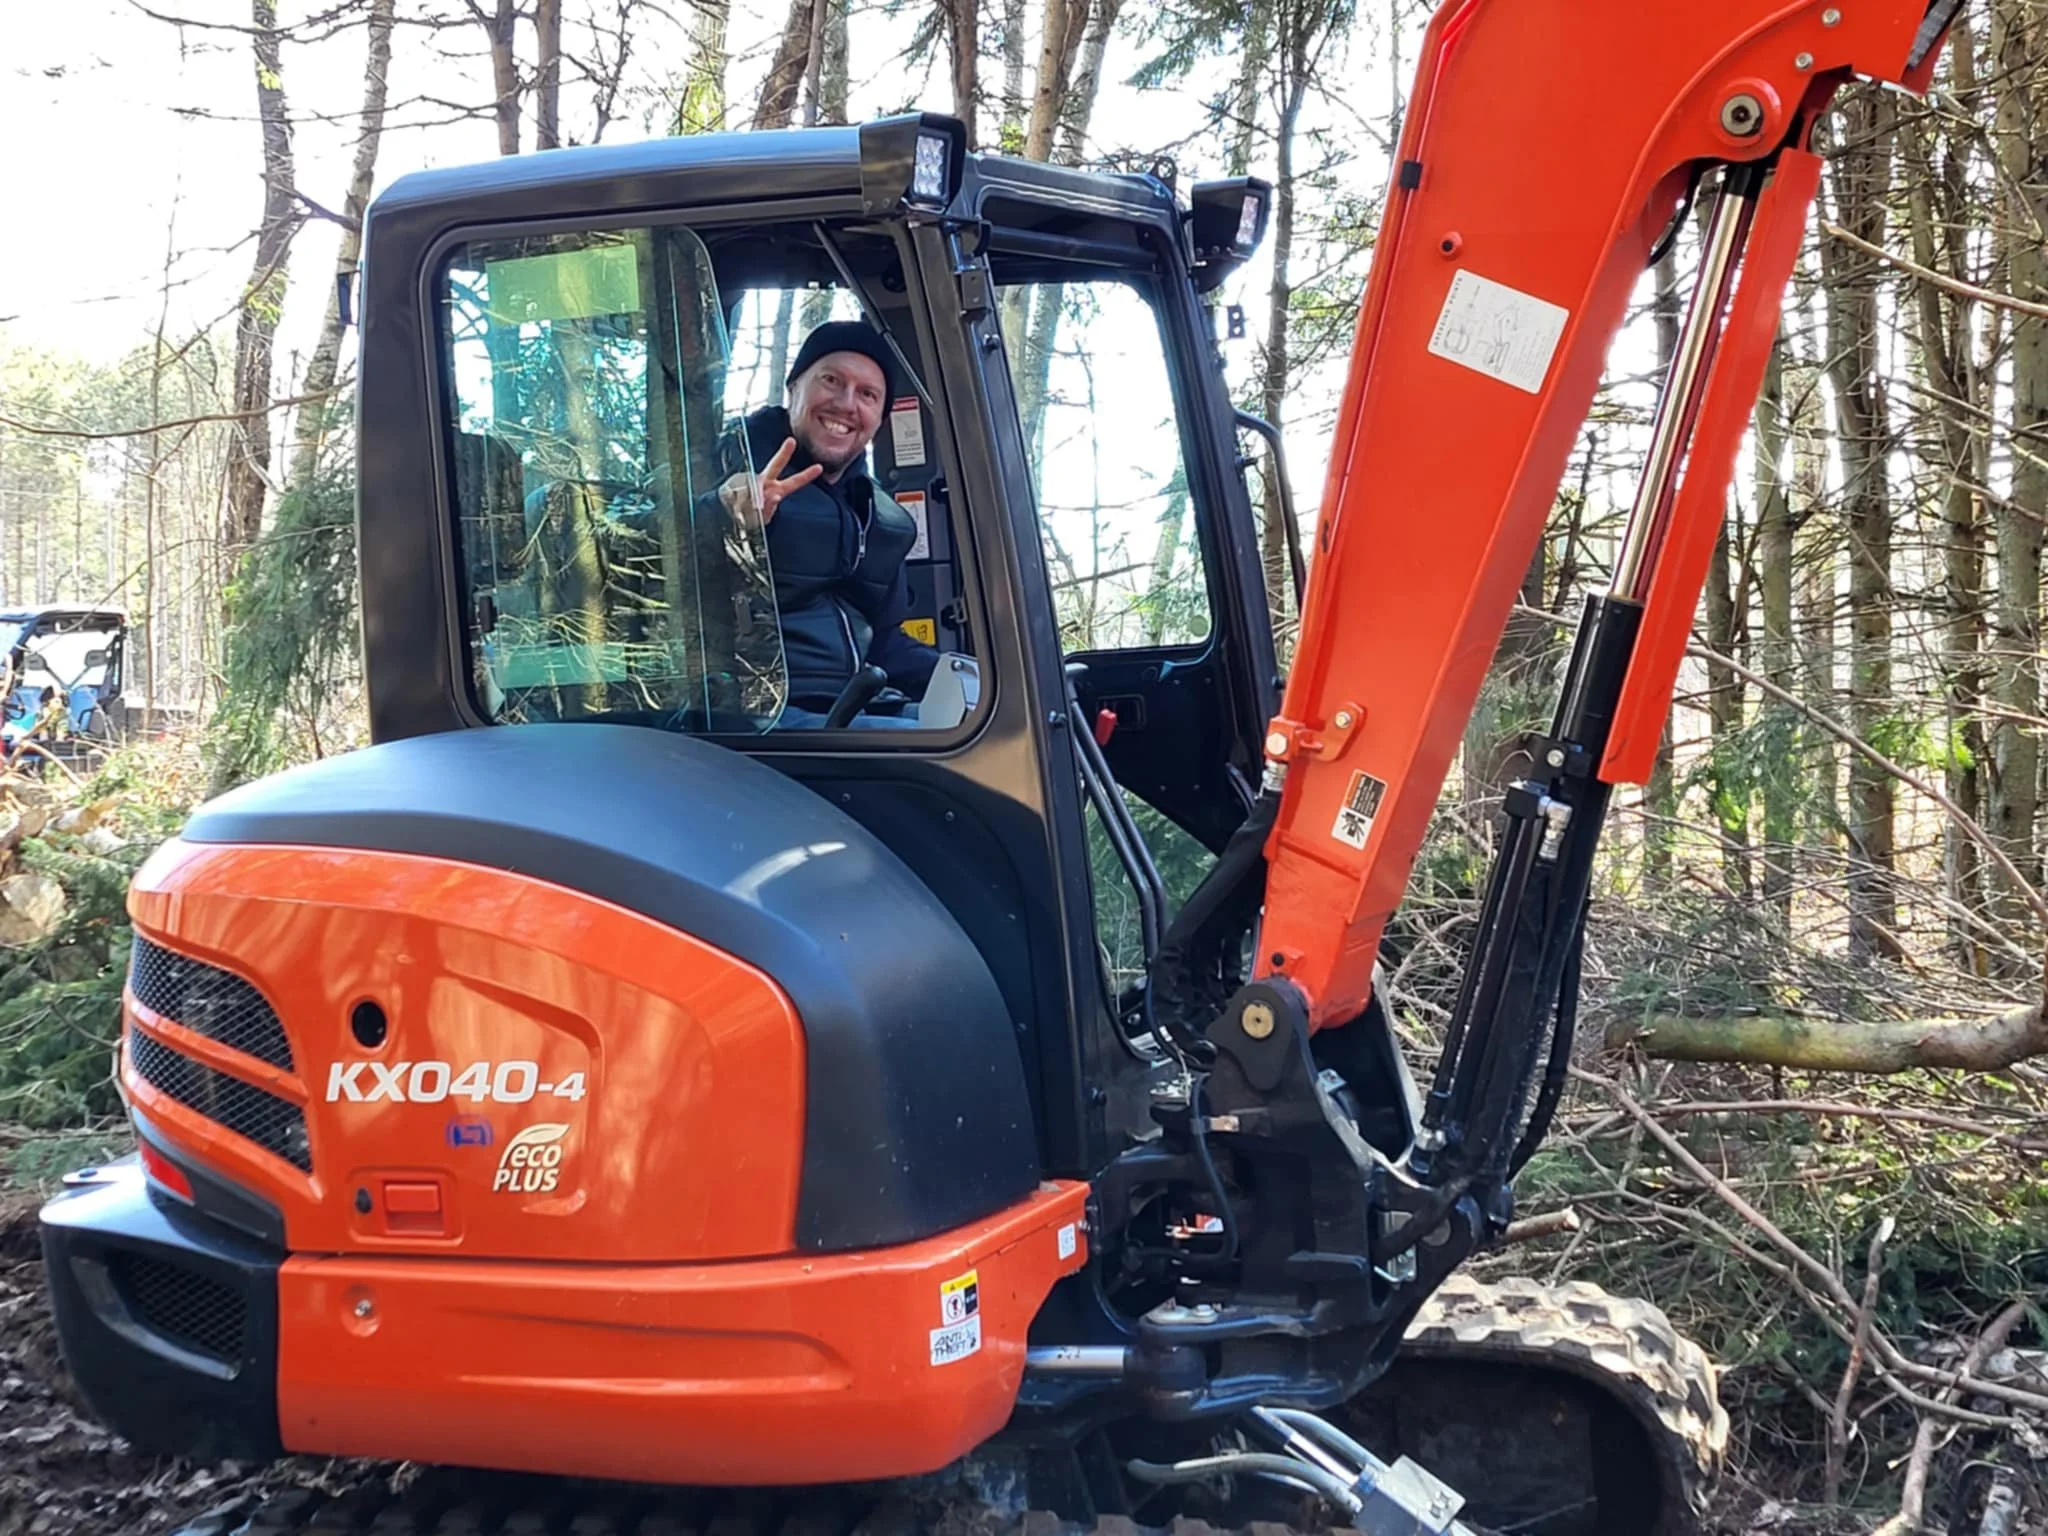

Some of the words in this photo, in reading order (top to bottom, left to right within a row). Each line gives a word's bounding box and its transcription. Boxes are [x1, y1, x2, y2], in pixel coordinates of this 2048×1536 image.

[325, 1061, 586, 1103] KX040-4
[511, 1145, 561, 1167] eco
[493, 1168, 560, 1192] PLUS
